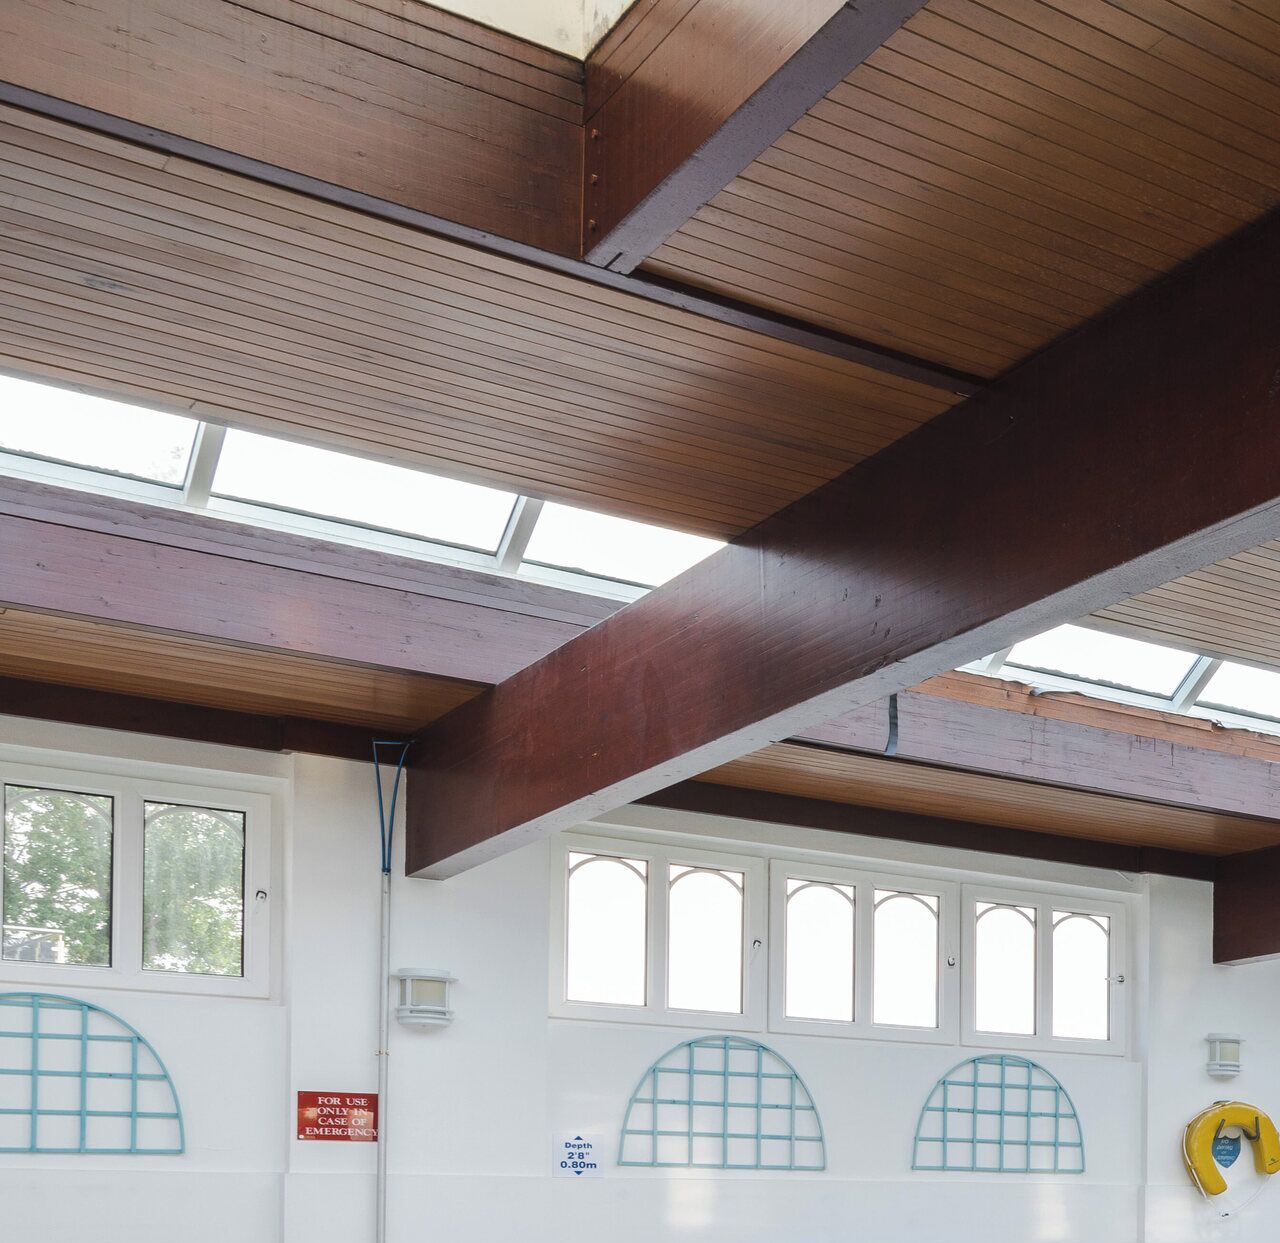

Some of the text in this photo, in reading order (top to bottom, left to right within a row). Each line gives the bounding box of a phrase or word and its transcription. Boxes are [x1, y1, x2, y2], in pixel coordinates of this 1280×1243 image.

[317, 1096, 368, 1106] FOR USE
[317, 1106, 349, 1115] ONLY
[317, 1117, 368, 1126] CASE OF
[305, 1127, 379, 1137] EMERGENCY
[564, 1142, 593, 1150] Depth
[567, 1151, 590, 1160] 2'8"
[560, 1160, 597, 1169] 0.80m
